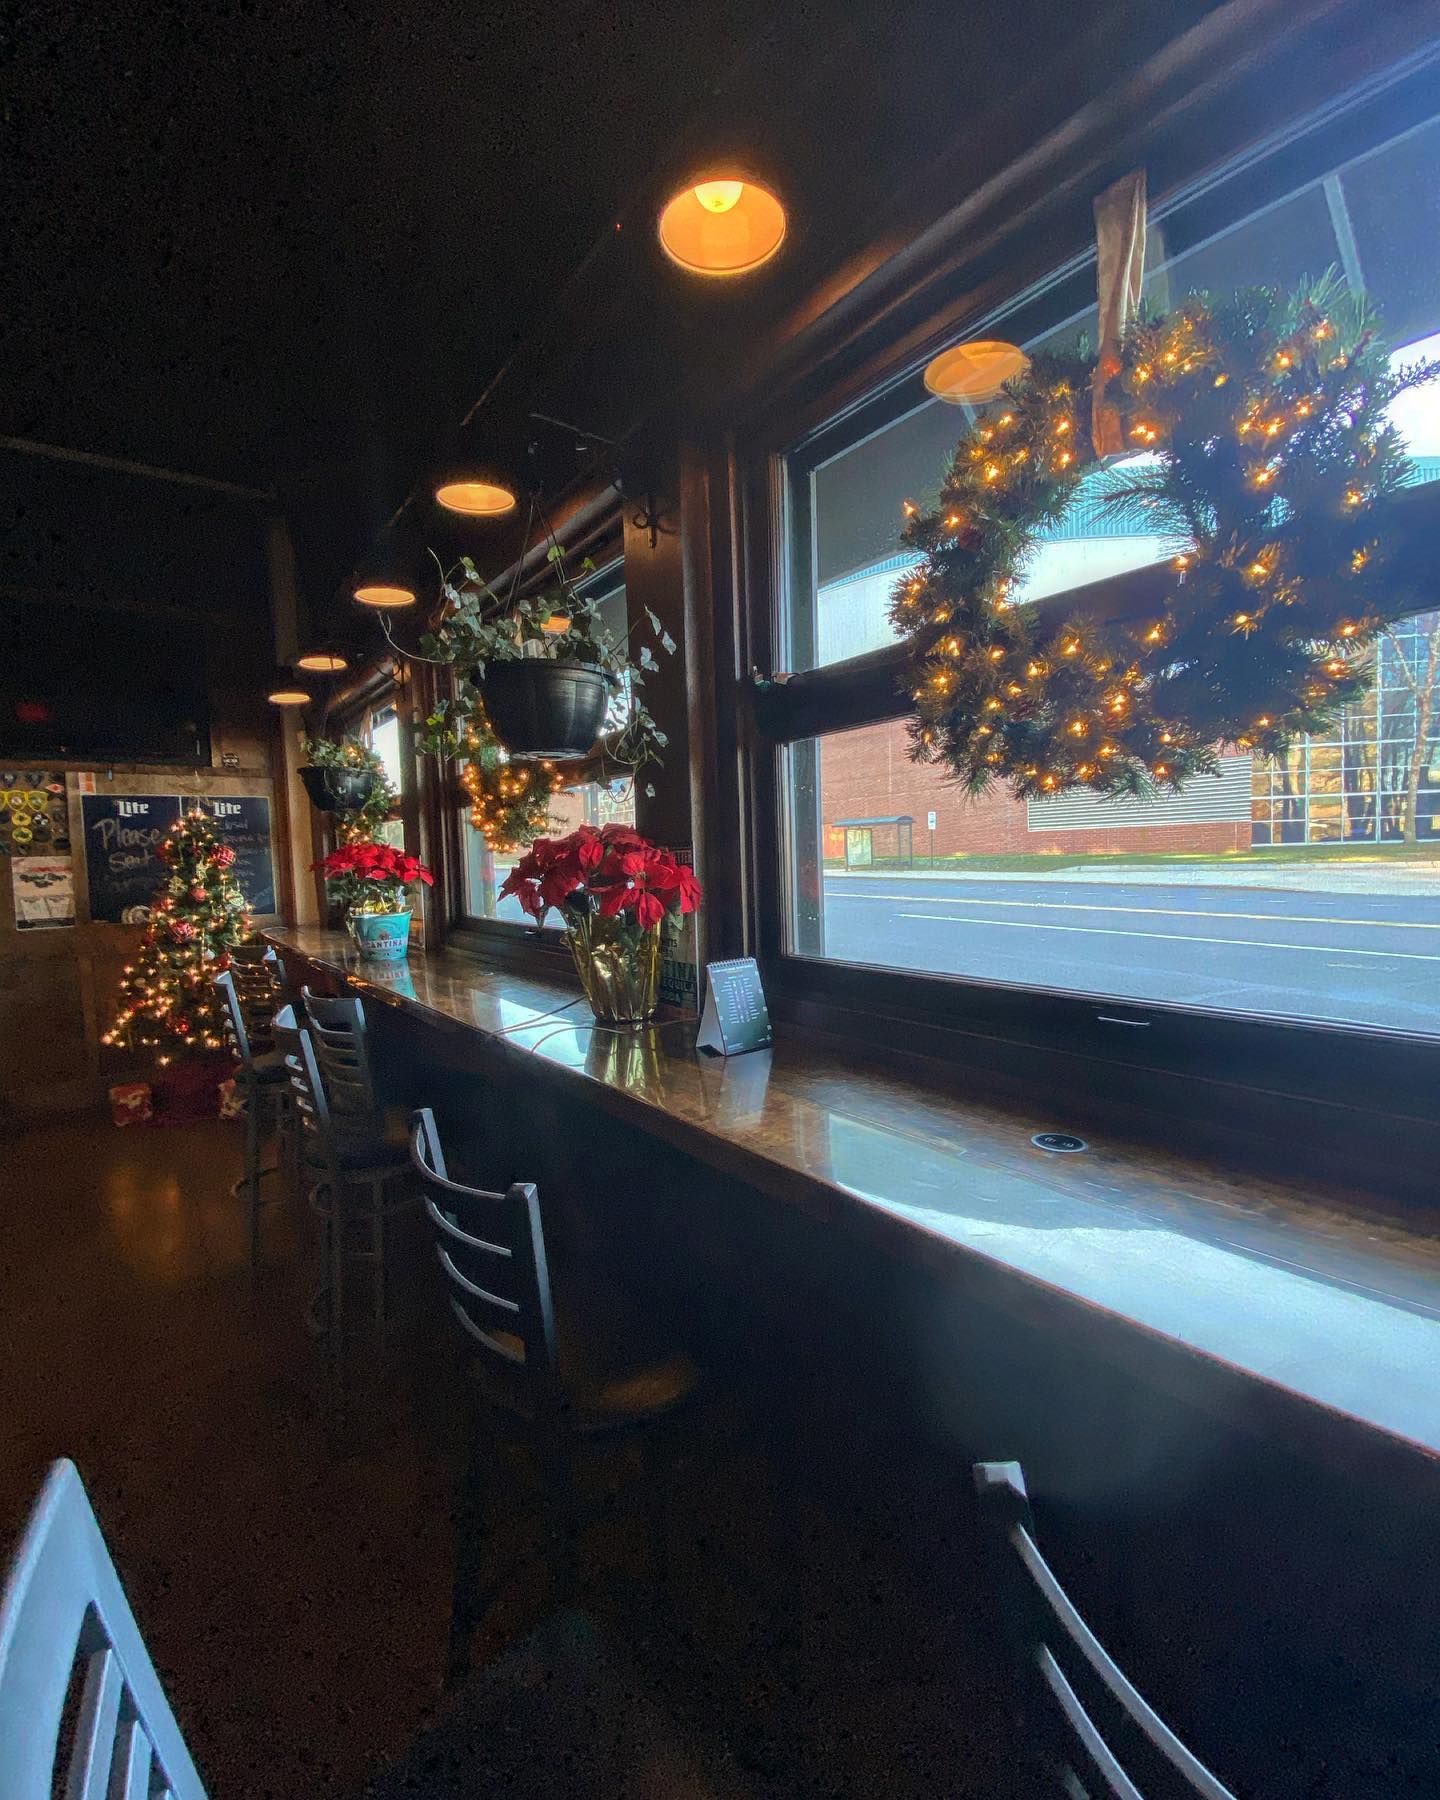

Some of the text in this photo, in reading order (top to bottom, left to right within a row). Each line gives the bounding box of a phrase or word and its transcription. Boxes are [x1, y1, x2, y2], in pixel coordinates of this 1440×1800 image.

[118, 801, 149, 817] Lite
[214, 802, 241, 817] Lite
[92, 818, 160, 849] Please
